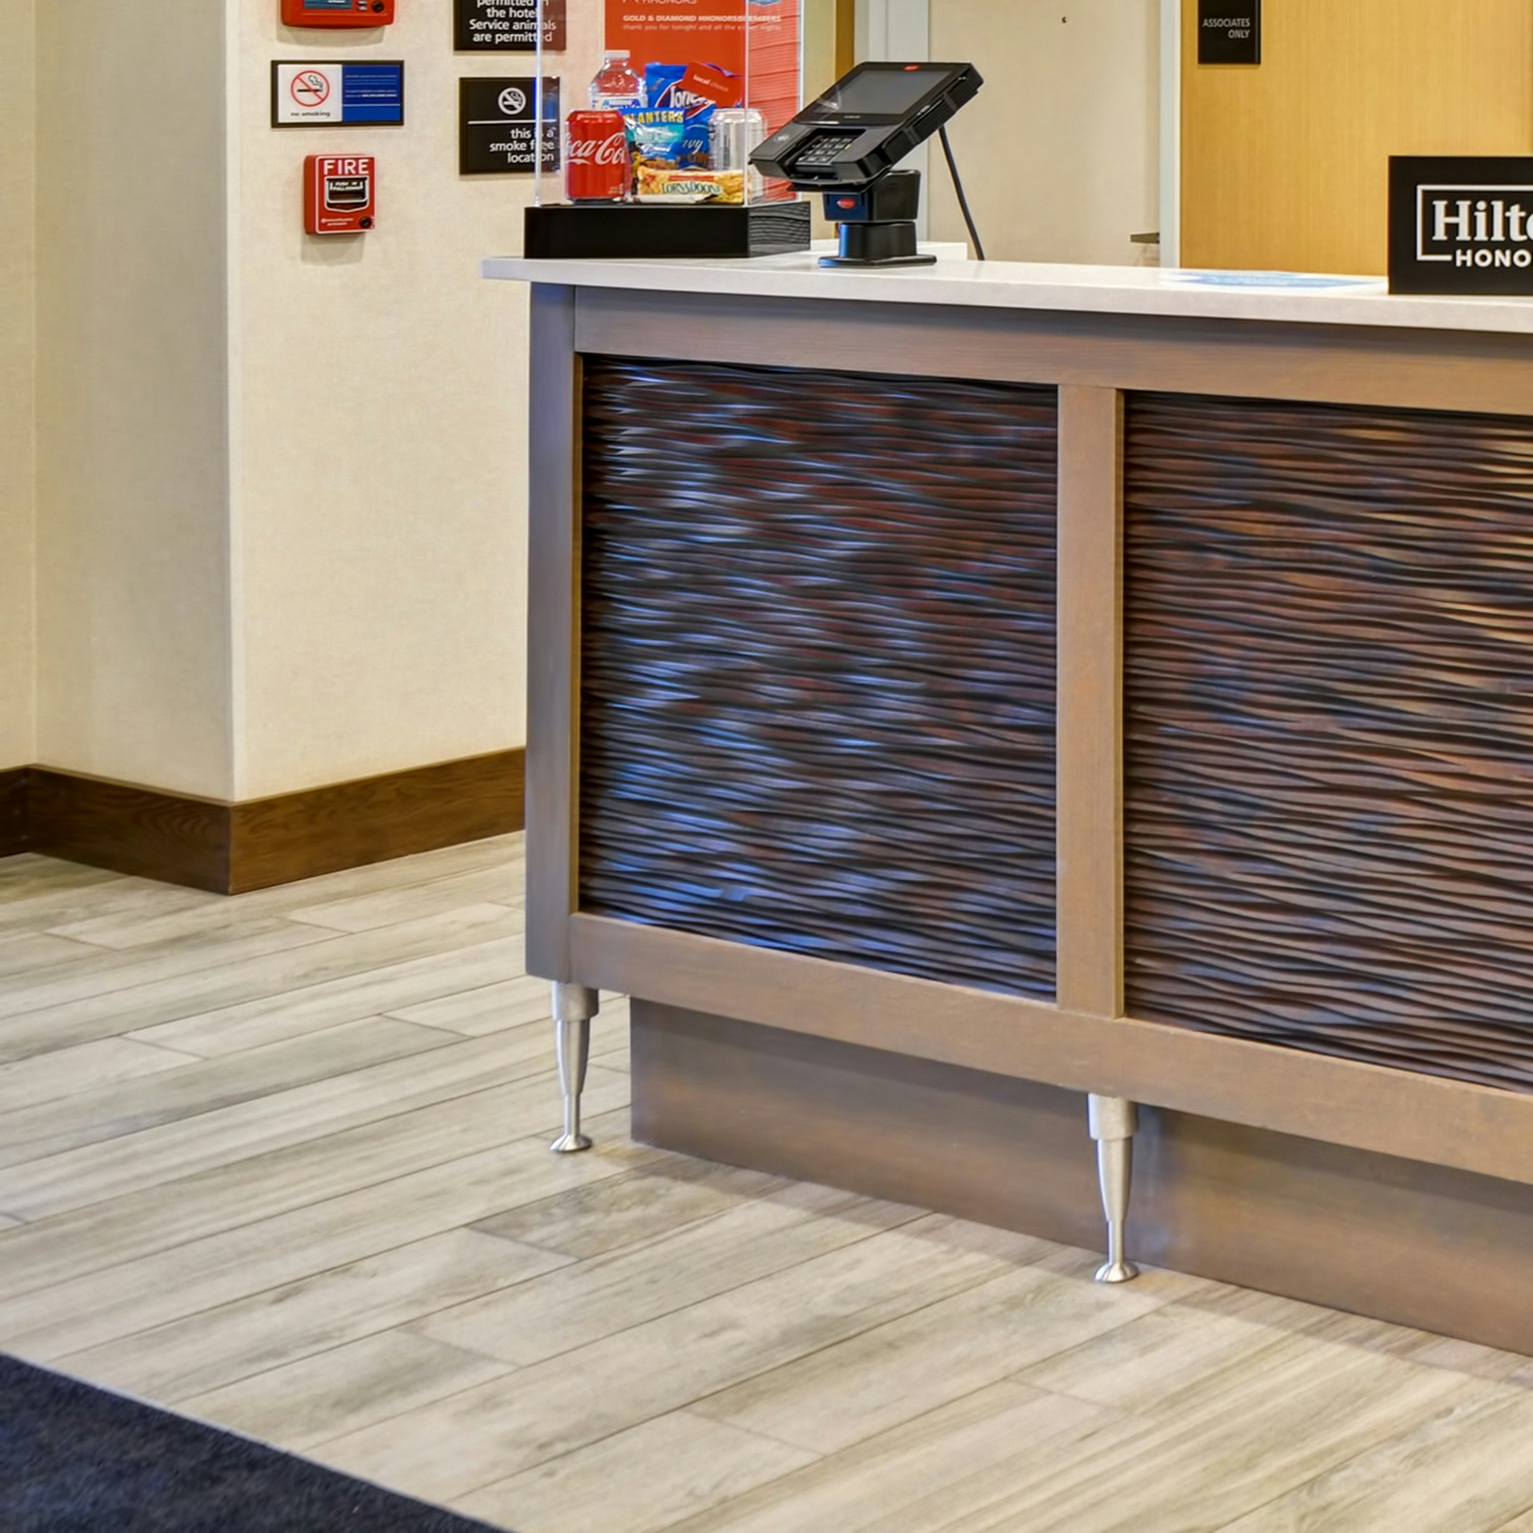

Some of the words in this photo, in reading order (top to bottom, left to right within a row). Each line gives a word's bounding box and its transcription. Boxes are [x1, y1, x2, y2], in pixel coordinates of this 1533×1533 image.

[486, 7, 506, 18] the
[509, 7, 540, 18] hote
[469, 19, 510, 31] Service
[1202, 18, 1250, 27] ASSOCIATES
[472, 33, 492, 42] are
[495, 31, 553, 44] permittd
[1228, 29, 1250, 39] ONLY
[510, 128, 532, 139] this
[489, 140, 527, 152] smoke
[529, 139, 555, 150] fee
[507, 152, 554, 163] locaton
[324, 159, 369, 175] FIRE
